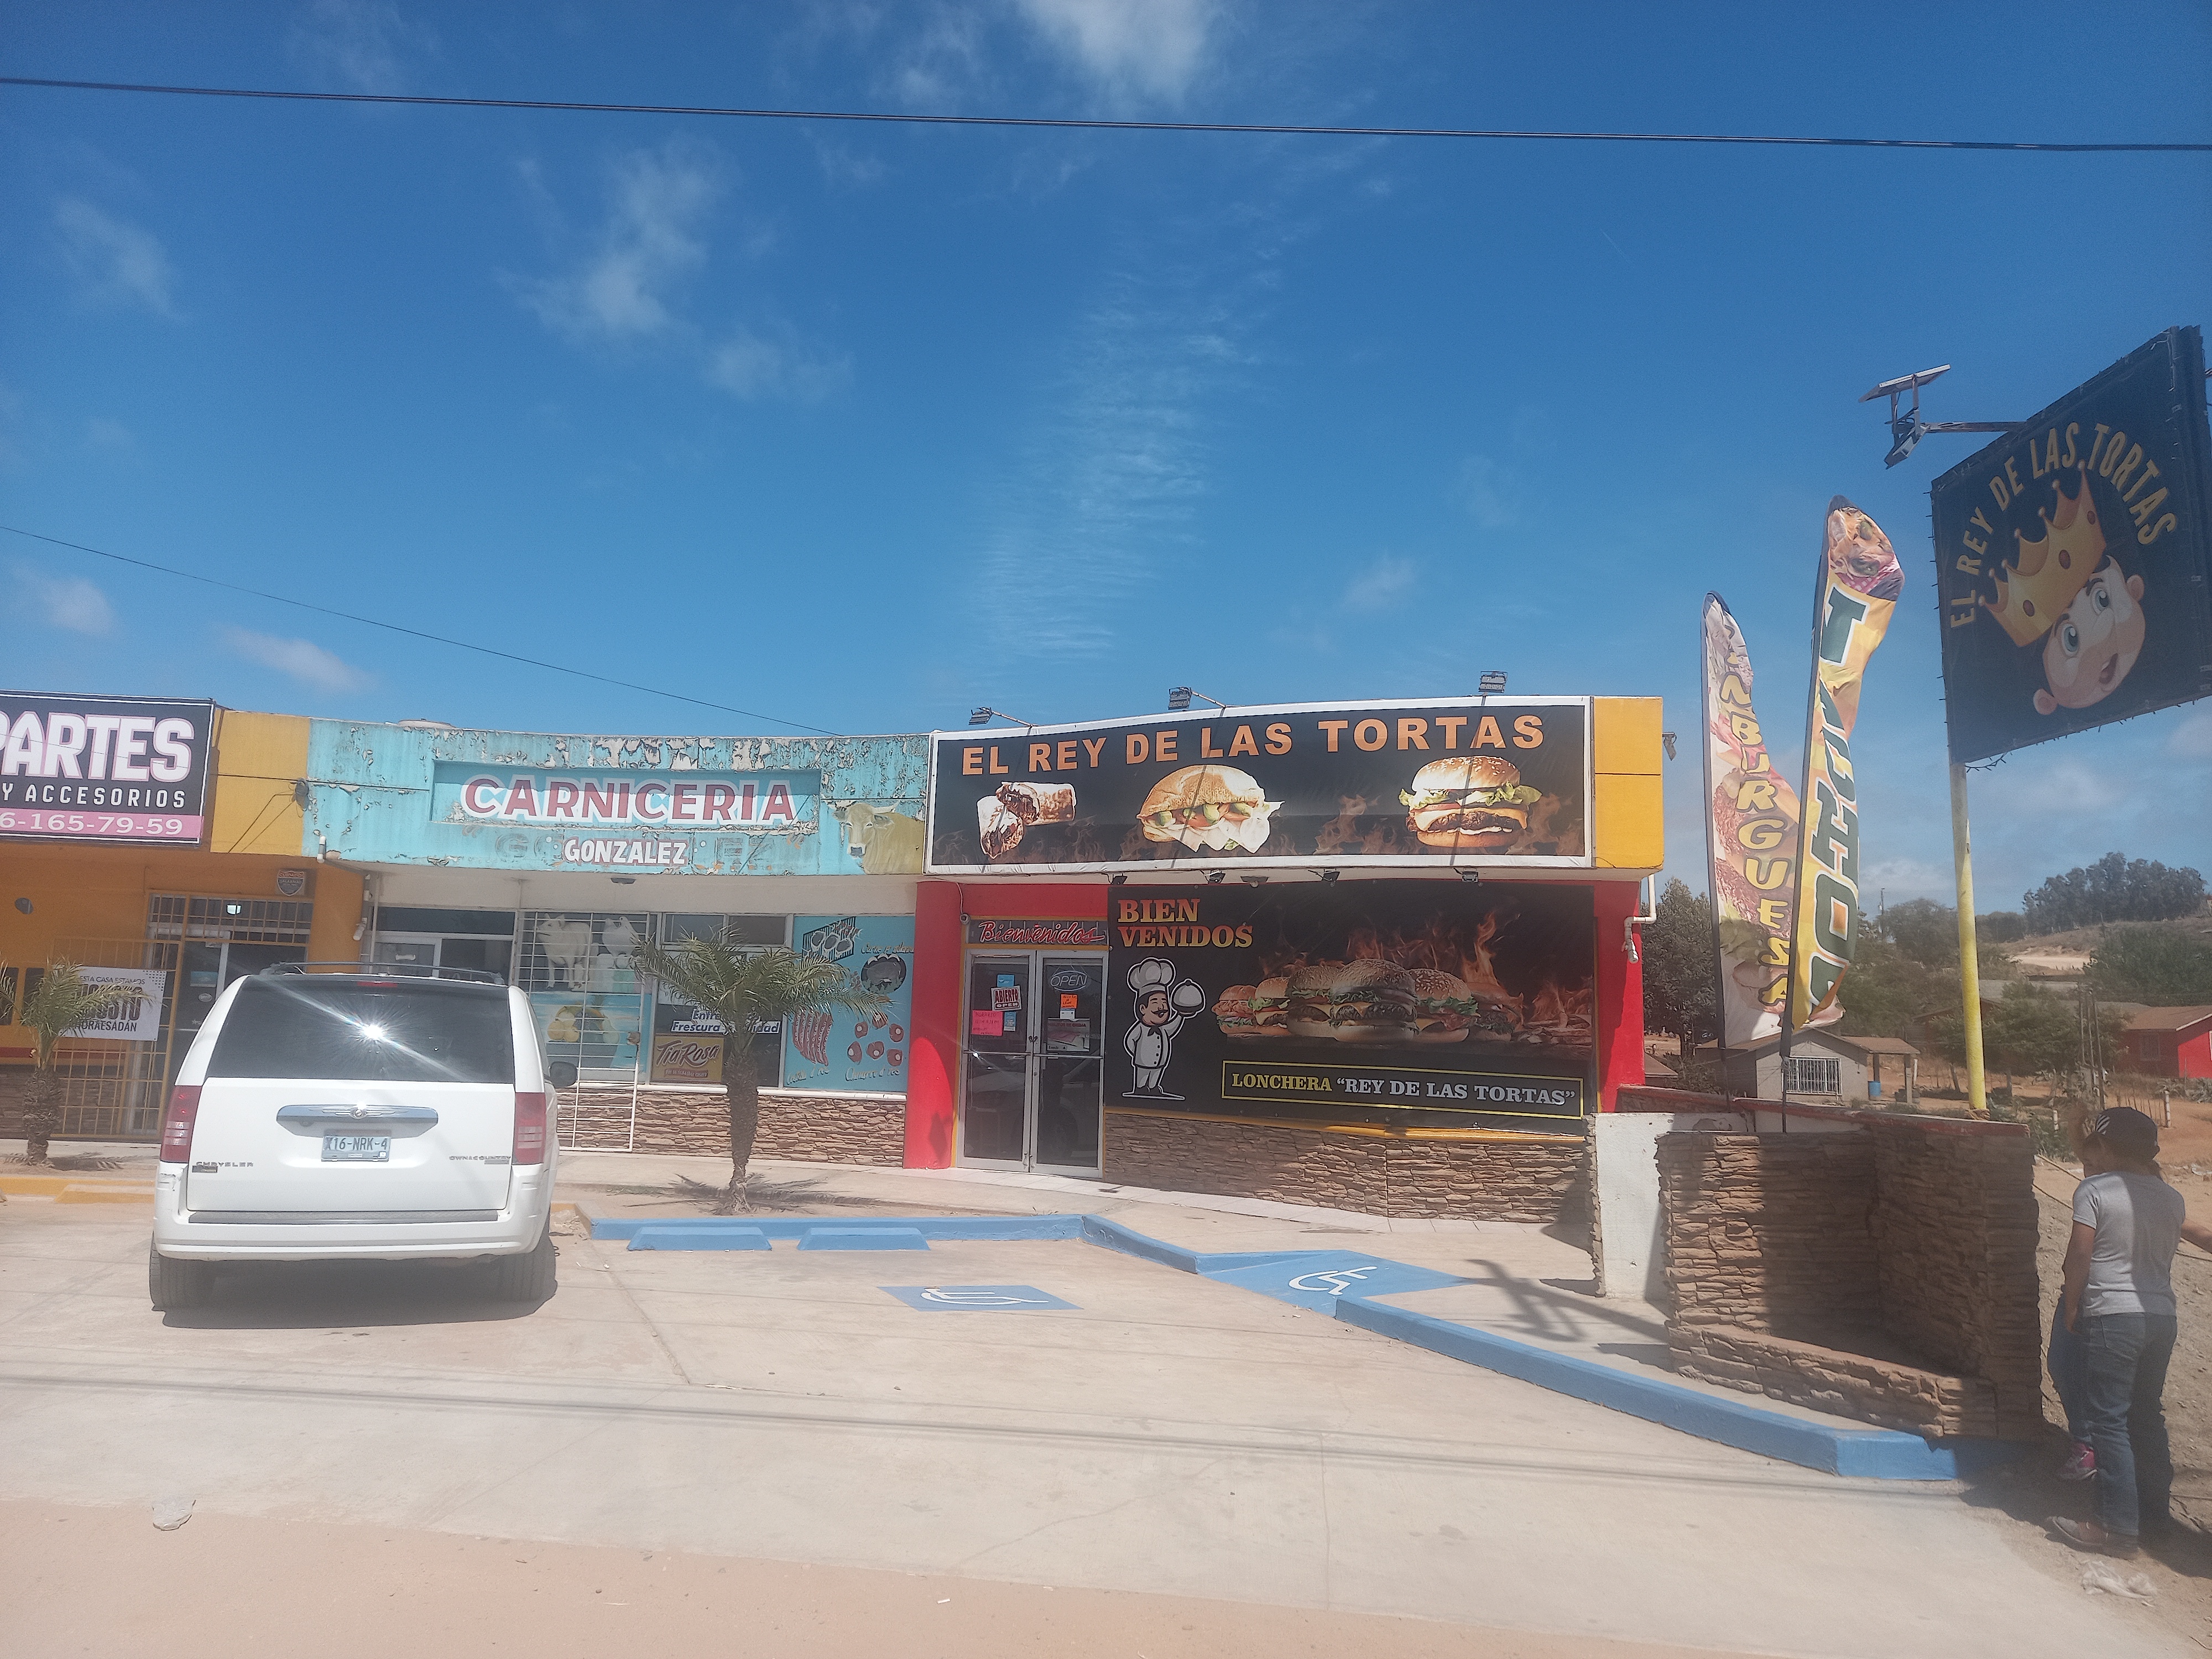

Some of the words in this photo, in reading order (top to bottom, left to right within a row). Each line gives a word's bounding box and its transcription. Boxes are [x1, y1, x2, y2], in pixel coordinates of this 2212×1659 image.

[2029, 421, 2081, 481] LAS
[1990, 455, 2025, 512] DE
[2086, 422, 2178, 545] TORTAS
[1955, 507, 1993, 575] REY
[1950, 590, 1976, 629] EL
[0, 710, 194, 782] ARTES
[962, 747, 1009, 775] EL
[1029, 737, 1107, 772] REY
[1125, 730, 1178, 764] DE
[1201, 722, 1292, 759] LAS
[1318, 714, 1546, 754] TORTAS
[2, 782, 13, 801] Y
[25, 784, 186, 808] ACCESORIOS
[462, 775, 797, 823] CARNICERIA
[0, 812, 183, 836] 6-165-79-59
[563, 837, 688, 865] GONZALEZ
[1118, 898, 1200, 923] BIEN
[978, 921, 1105, 945] Bienvenidos
[1118, 924, 1253, 948] VENIDOS
[1051, 974, 1087, 987] OPEN
[995, 988, 1019, 1003] ABIERTO
[672, 1021, 721, 1032] Frescura
[679, 1042, 721, 1067] Rosa
[1232, 1072, 1332, 1092] LONCHERA
[1389, 1080, 1420, 1098] DE
[1426, 1082, 1467, 1100] LAS
